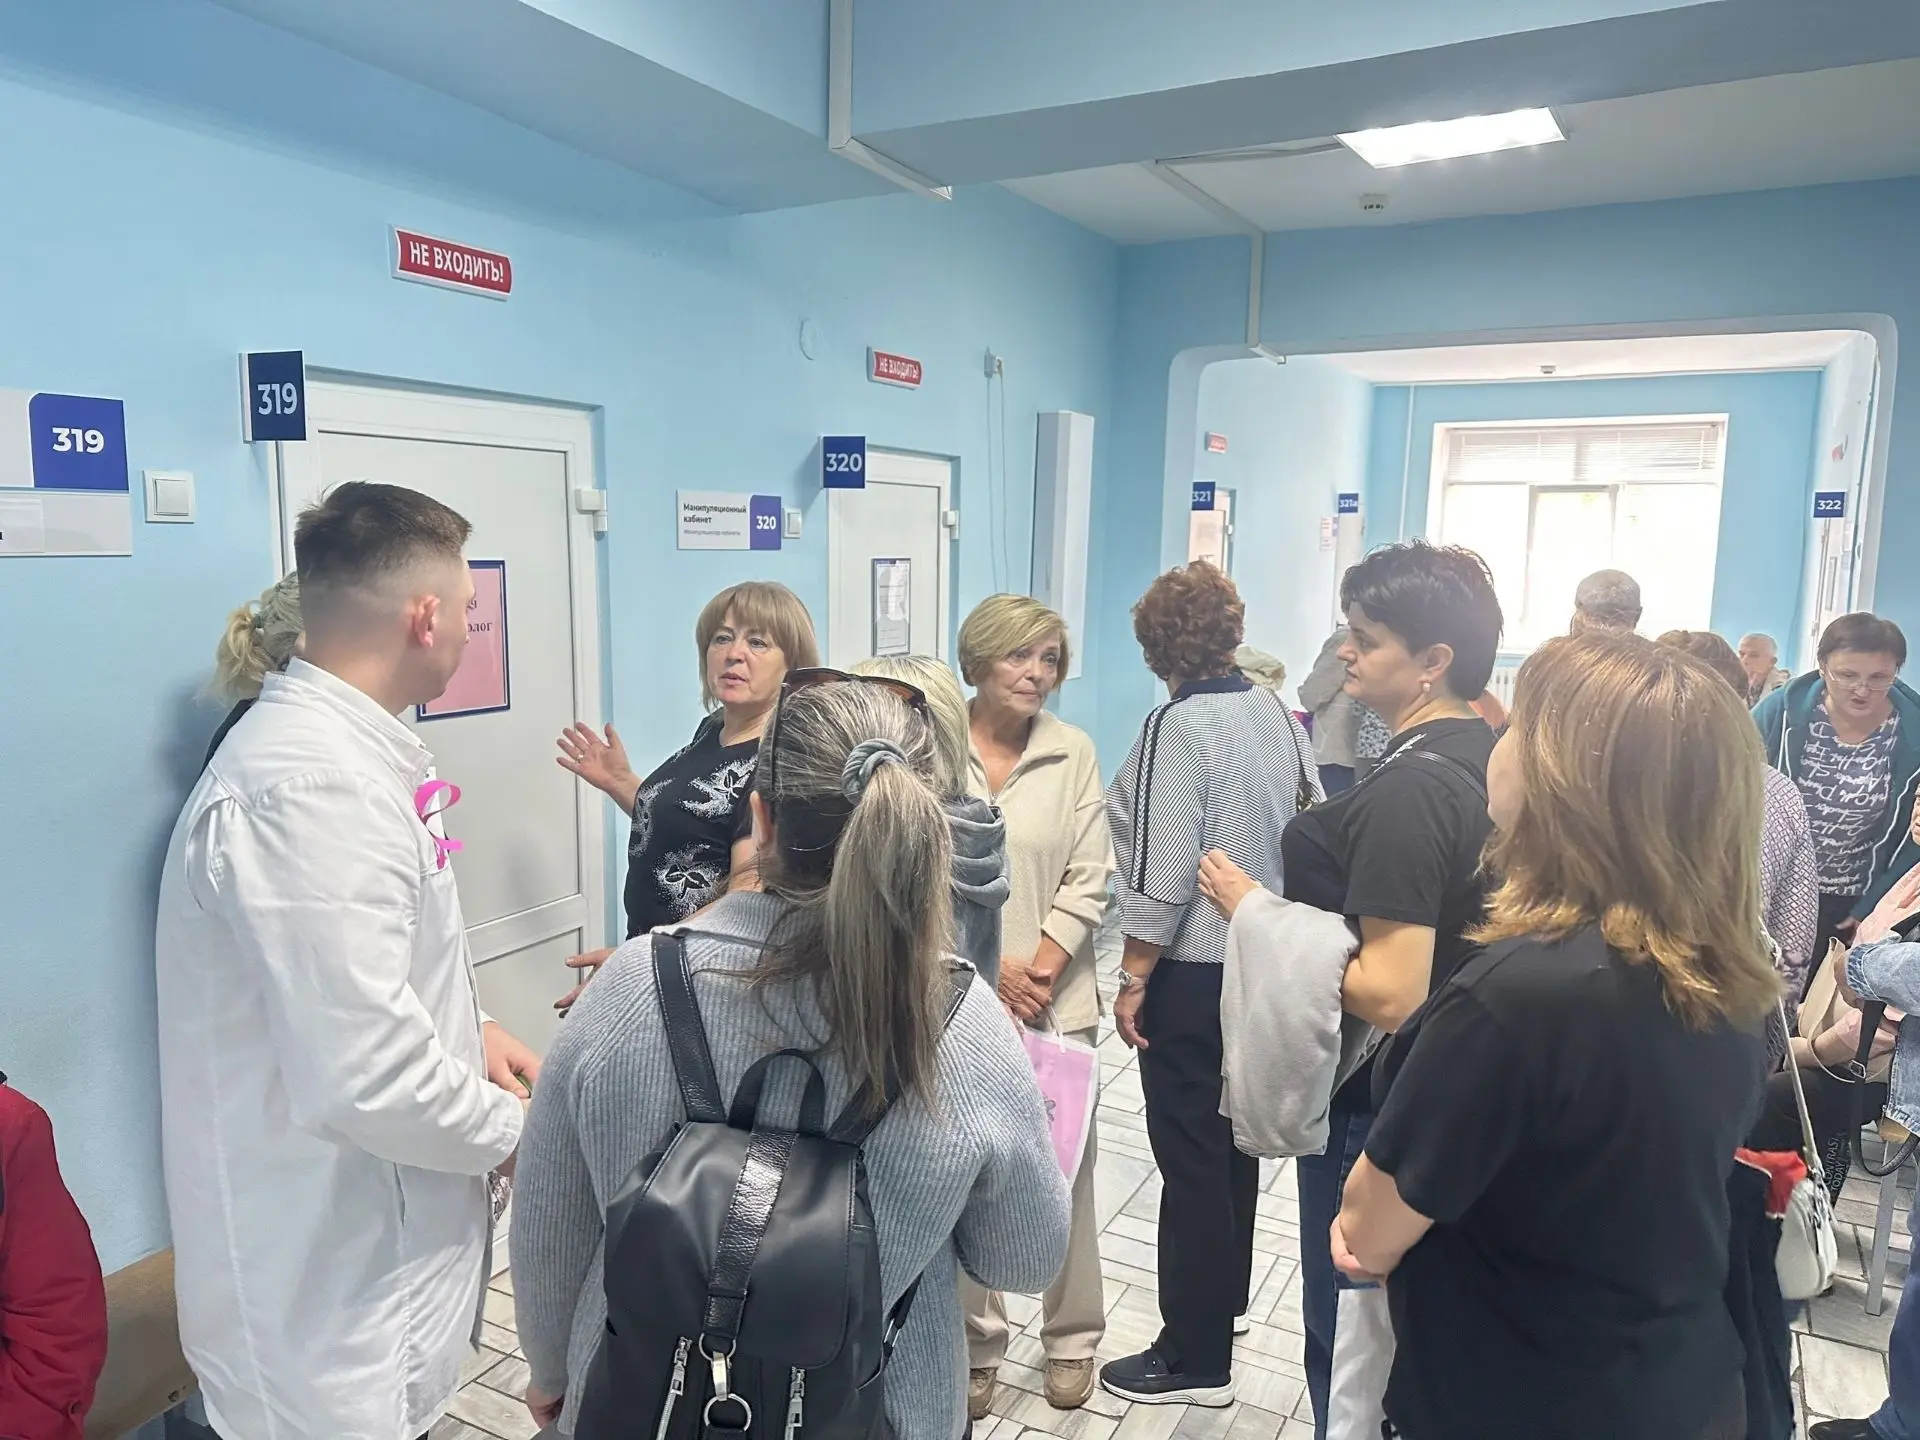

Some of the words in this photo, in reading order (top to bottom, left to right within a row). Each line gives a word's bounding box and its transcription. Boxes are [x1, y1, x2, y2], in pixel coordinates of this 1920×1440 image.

[410, 241, 429, 267] НЕ
[433, 247, 504, 283] ВХОДИТЬ!
[879, 357, 888, 373] НЕ
[889, 359, 919, 379] ВХОДИТЬ!
[257, 382, 298, 415] 319
[52, 427, 105, 454] 319
[825, 453, 862, 472] 320
[683, 503, 747, 514] Манипуляционный
[1817, 499, 1842, 510] 322
[683, 514, 712, 524] кабинет
[756, 515, 777, 530] 320
[1831, 1160, 1846, 1191] TODAY
